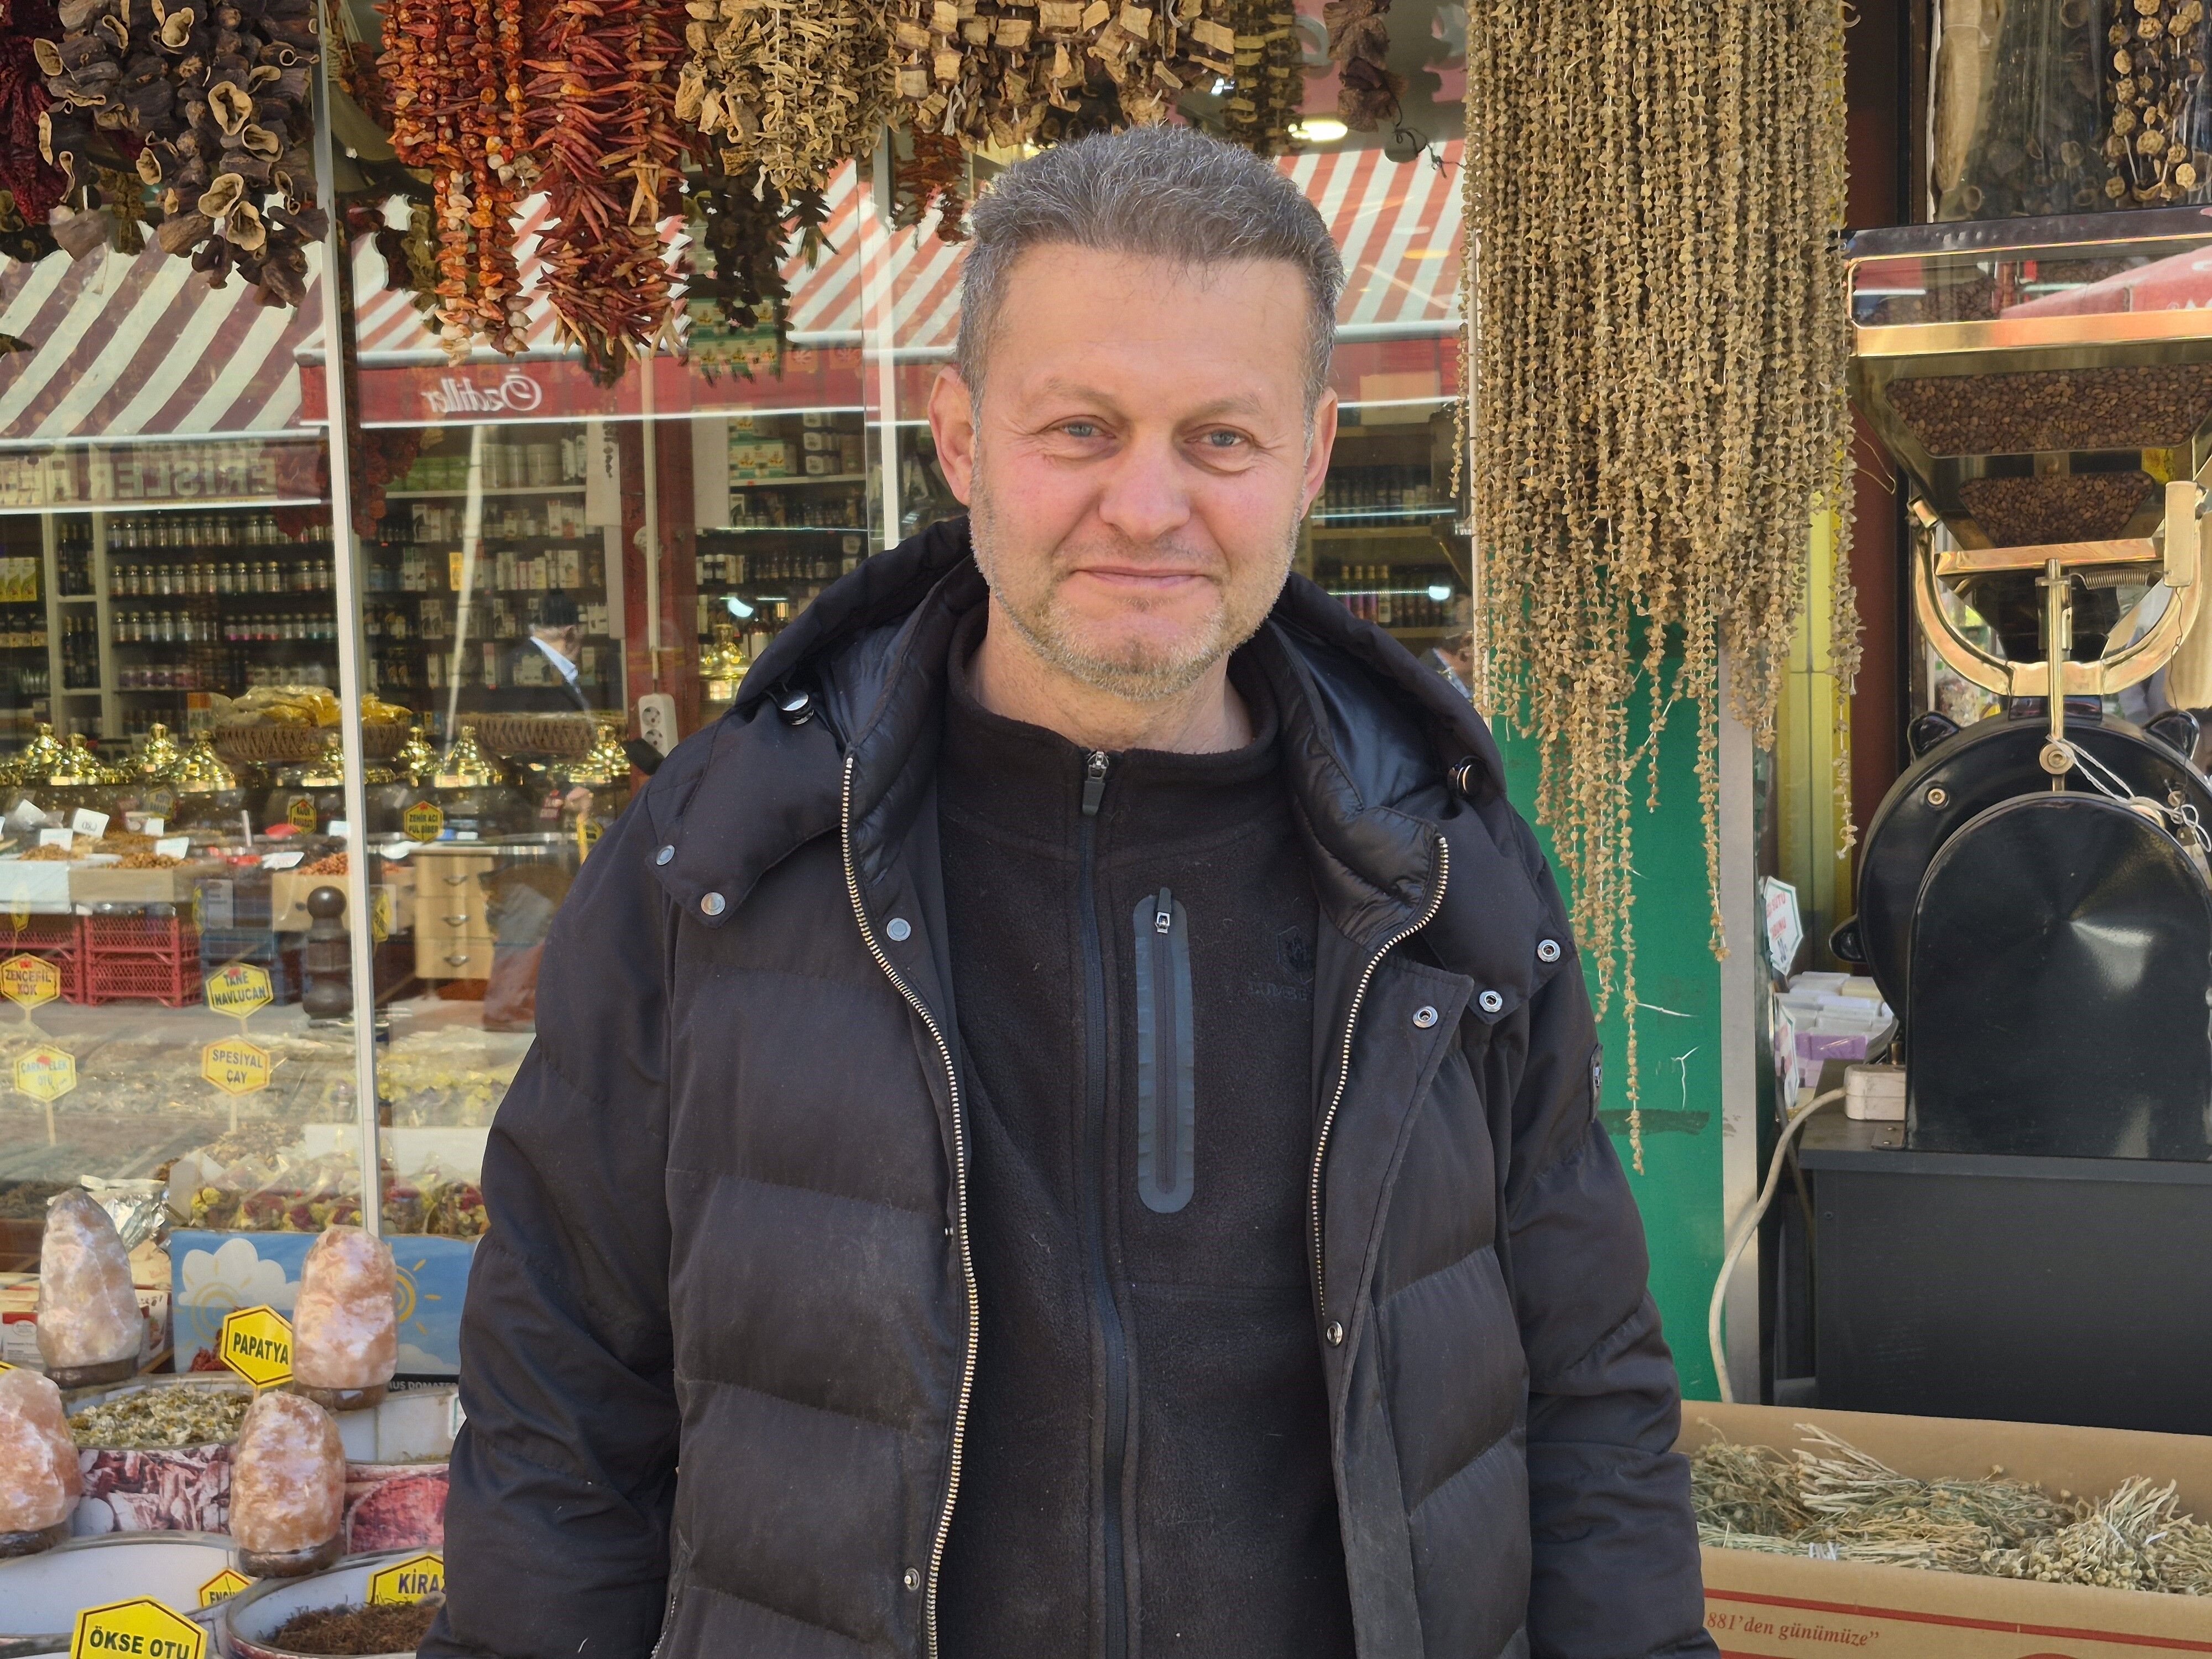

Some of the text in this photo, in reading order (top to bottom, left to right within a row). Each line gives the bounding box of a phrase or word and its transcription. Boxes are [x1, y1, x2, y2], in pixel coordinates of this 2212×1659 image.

[214, 985, 267, 1005] HAVLUCAN
[212, 1048, 263, 1068] SPESİYAL
[227, 1069, 247, 1084] ÇAY
[233, 1332, 289, 1365] PAPATYA
[90, 1625, 190, 1659] ÖKSE OTU
